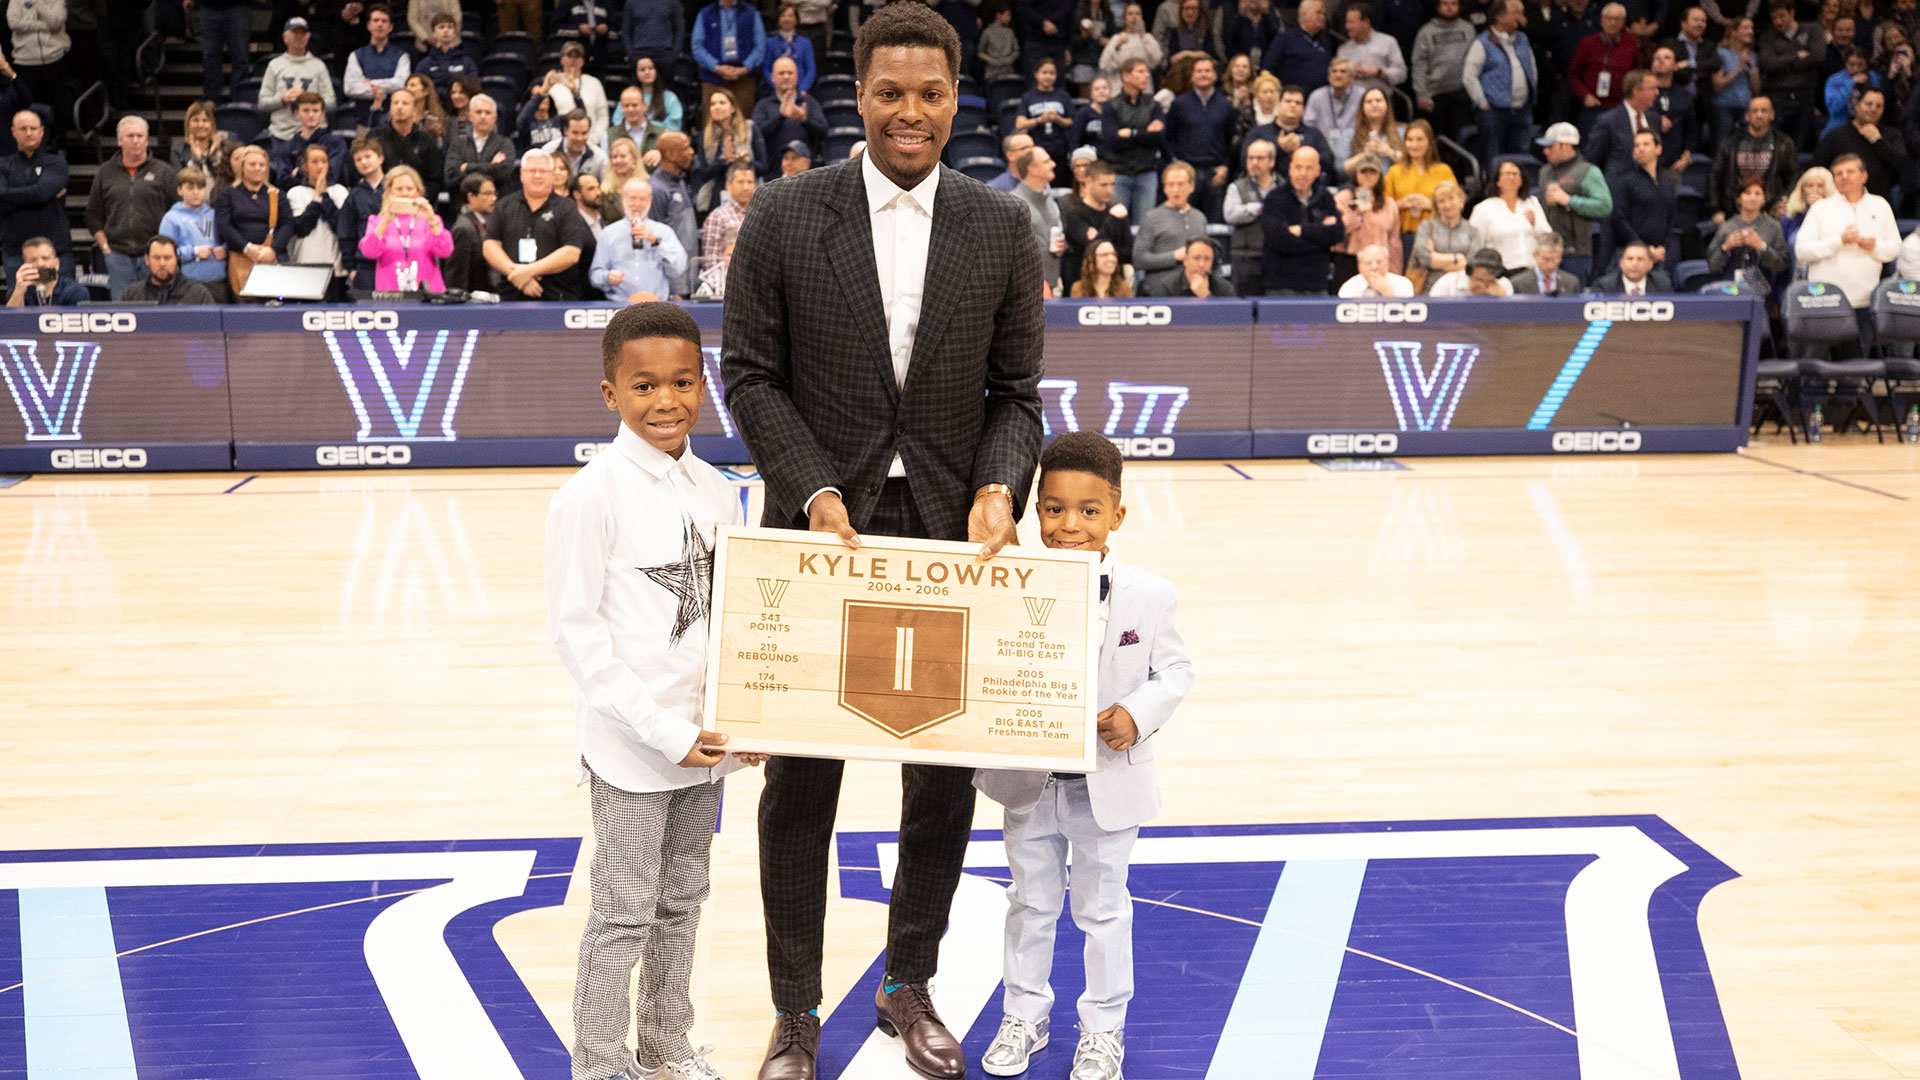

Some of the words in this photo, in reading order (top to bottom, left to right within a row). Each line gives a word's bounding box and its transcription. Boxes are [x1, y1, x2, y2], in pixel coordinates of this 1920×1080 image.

[1078, 305, 1172, 326] GEICO
[1336, 303, 1428, 323] GEICO
[1583, 301, 1675, 321] GEICO
[39, 312, 137, 333] GEICO
[303, 311, 399, 331] GEICO
[1307, 434, 1398, 454] GEICO
[1552, 432, 1641, 452] GEICO
[50, 448, 147, 469] GEICO
[316, 446, 411, 466] GEICO
[798, 552, 888, 579] KYLE
[906, 560, 1034, 589] LOWRY
[867, 581, 901, 592] 2004
[915, 585, 949, 596] 2006
[761, 613, 781, 622] 543
[750, 622, 790, 632] POINTS
[1018, 630, 1045, 639] 2006
[760, 642, 777, 652] 219
[997, 638, 1035, 648] Second
[1039, 641, 1065, 650] Team
[738, 651, 799, 663] REBOUNDS
[997, 648, 1034, 658] All-BIG
[1038, 651, 1065, 660] EAST
[758, 672, 775, 681] 174
[1017, 669, 1044, 679] 2005
[744, 681, 789, 692] ASSISTS
[983, 677, 1047, 689] Philadelphia
[1051, 681, 1068, 691] Big
[982, 686, 1018, 696] Rookie
[1021, 689, 1031, 697] of
[1036, 690, 1052, 699] the
[1056, 691, 1078, 700] Year
[1016, 708, 1043, 718] 2005
[995, 717, 1014, 727] BIG
[1018, 719, 1045, 729] EAST
[1049, 721, 1062, 729] All
[988, 727, 1038, 738] Freshman
[1042, 730, 1069, 740] Team
